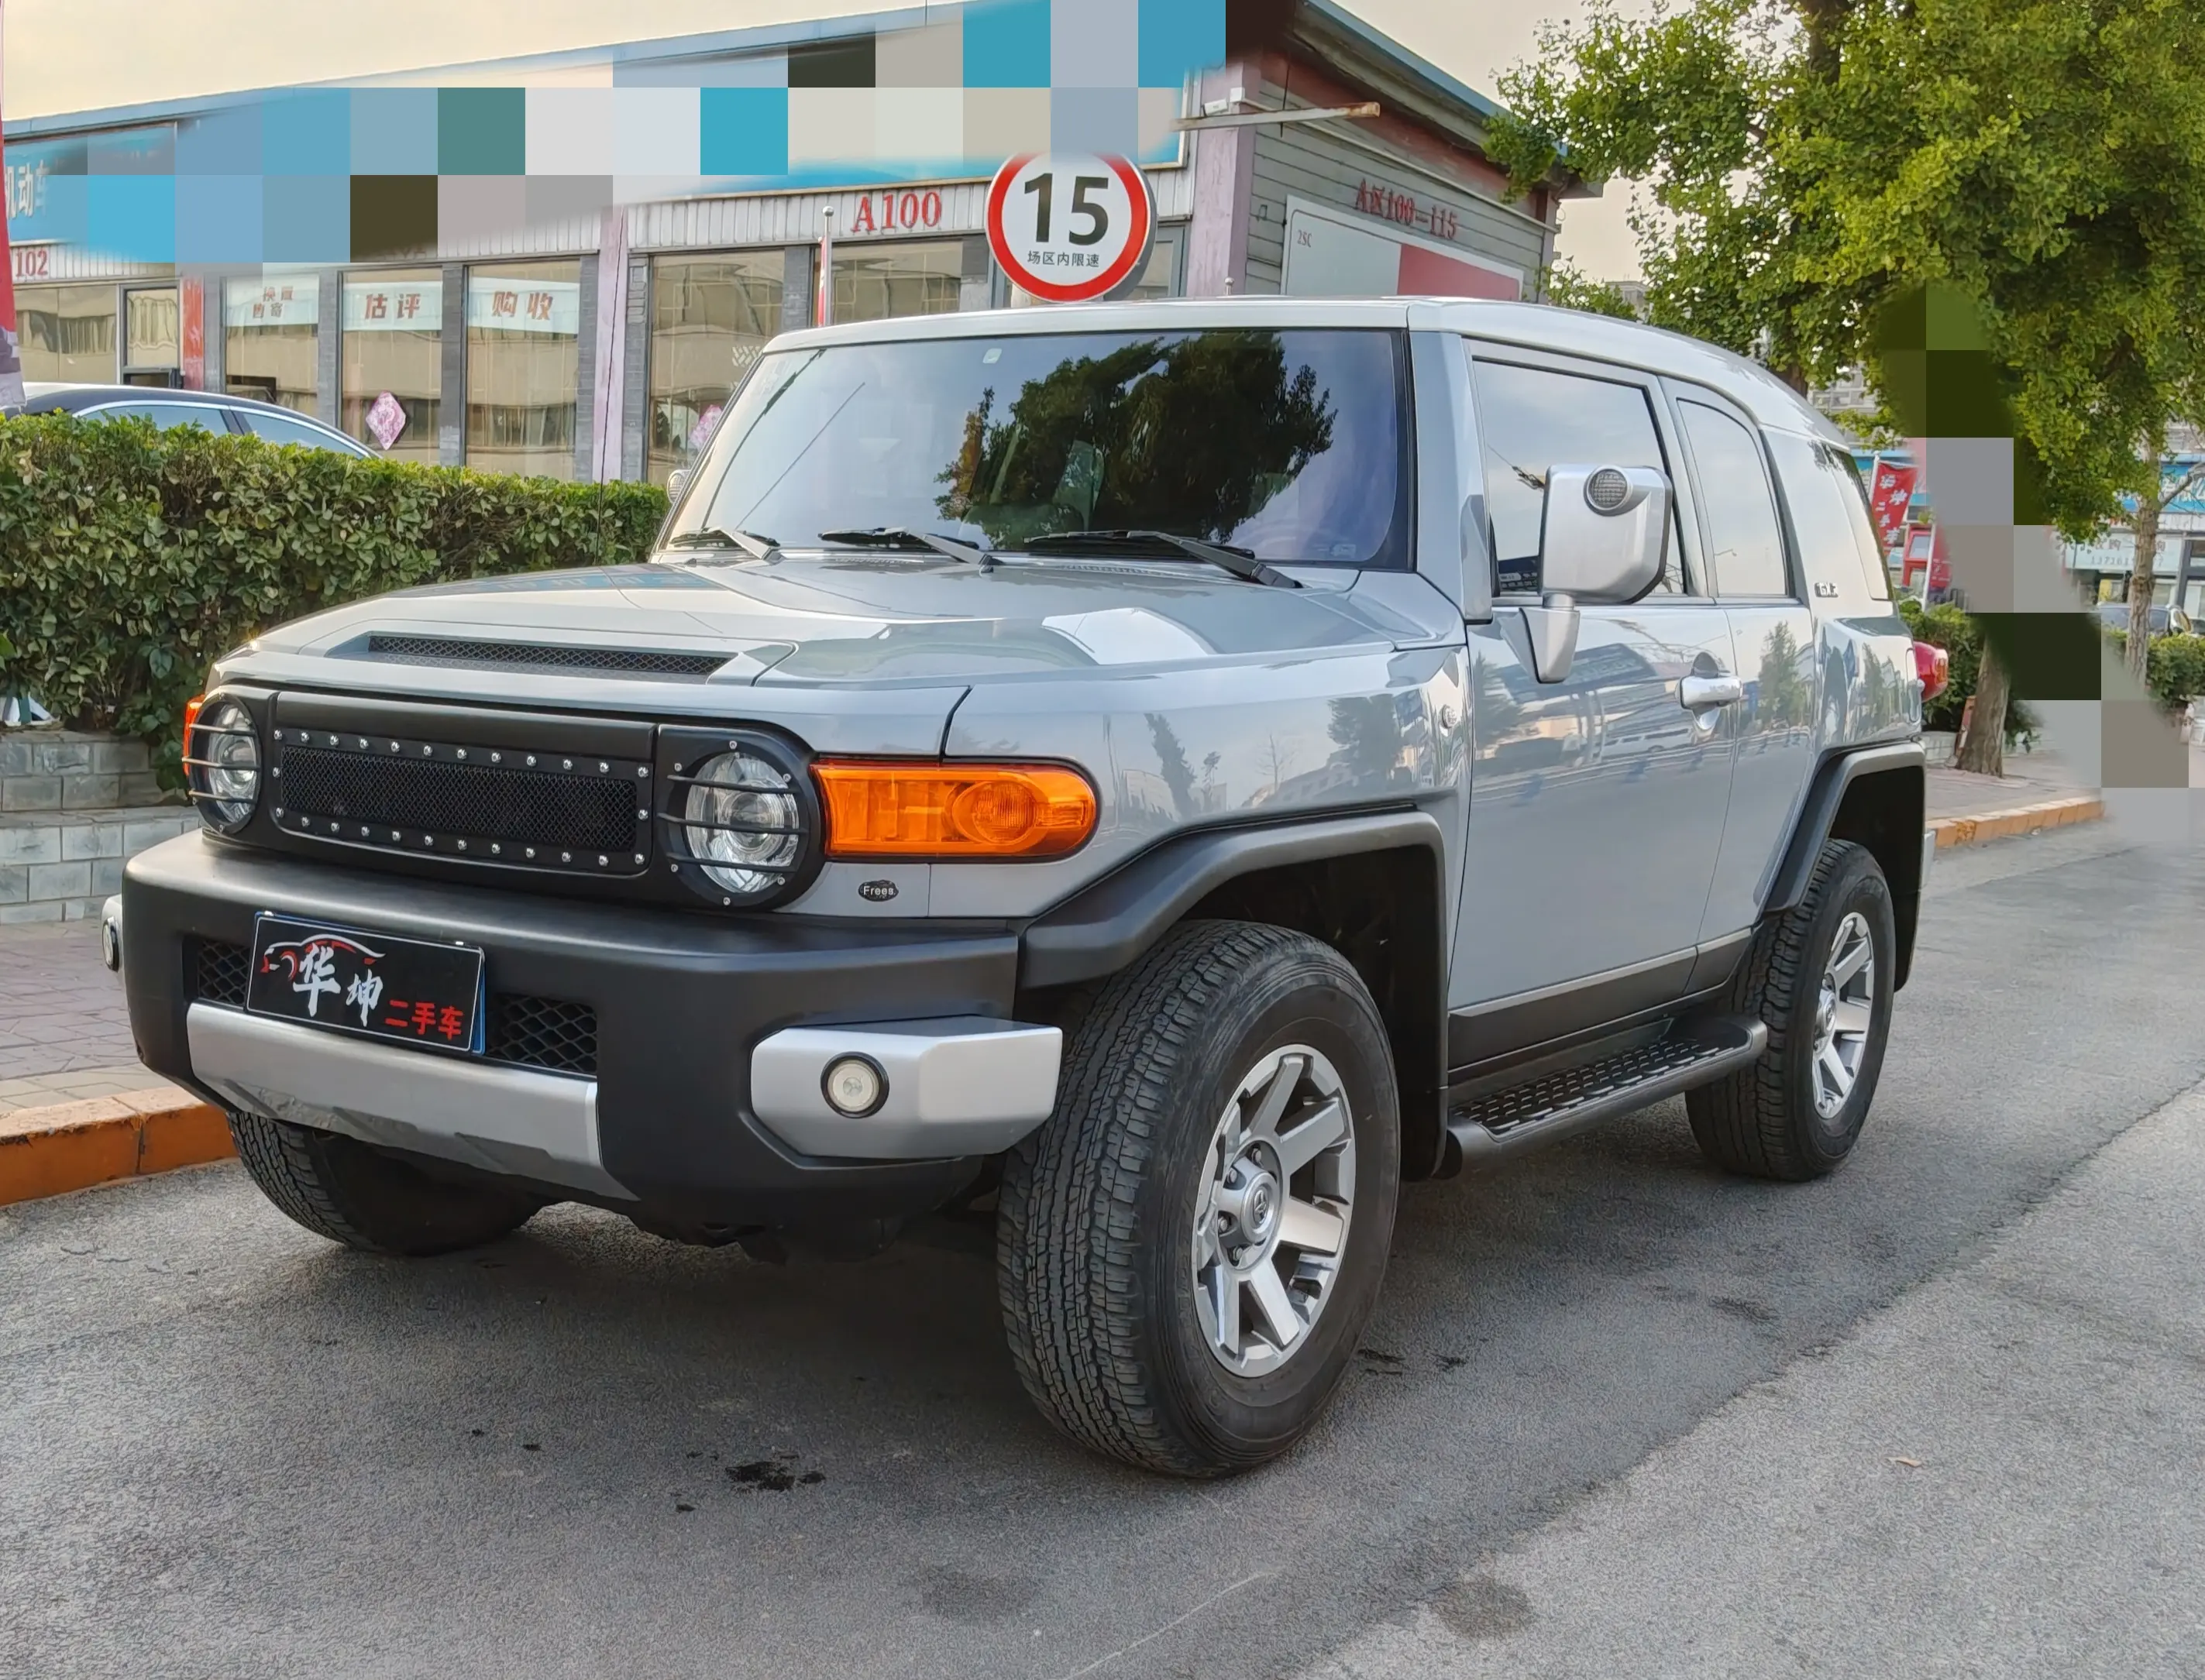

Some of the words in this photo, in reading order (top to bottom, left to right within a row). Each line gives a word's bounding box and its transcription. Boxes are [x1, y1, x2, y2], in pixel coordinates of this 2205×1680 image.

[852, 191, 942, 232] A100
[1023, 173, 1109, 246] 15
[1027, 249, 1100, 268] 场区内限速
[293, 943, 384, 1027] 华坤
[385, 999, 463, 1040] 二手车
